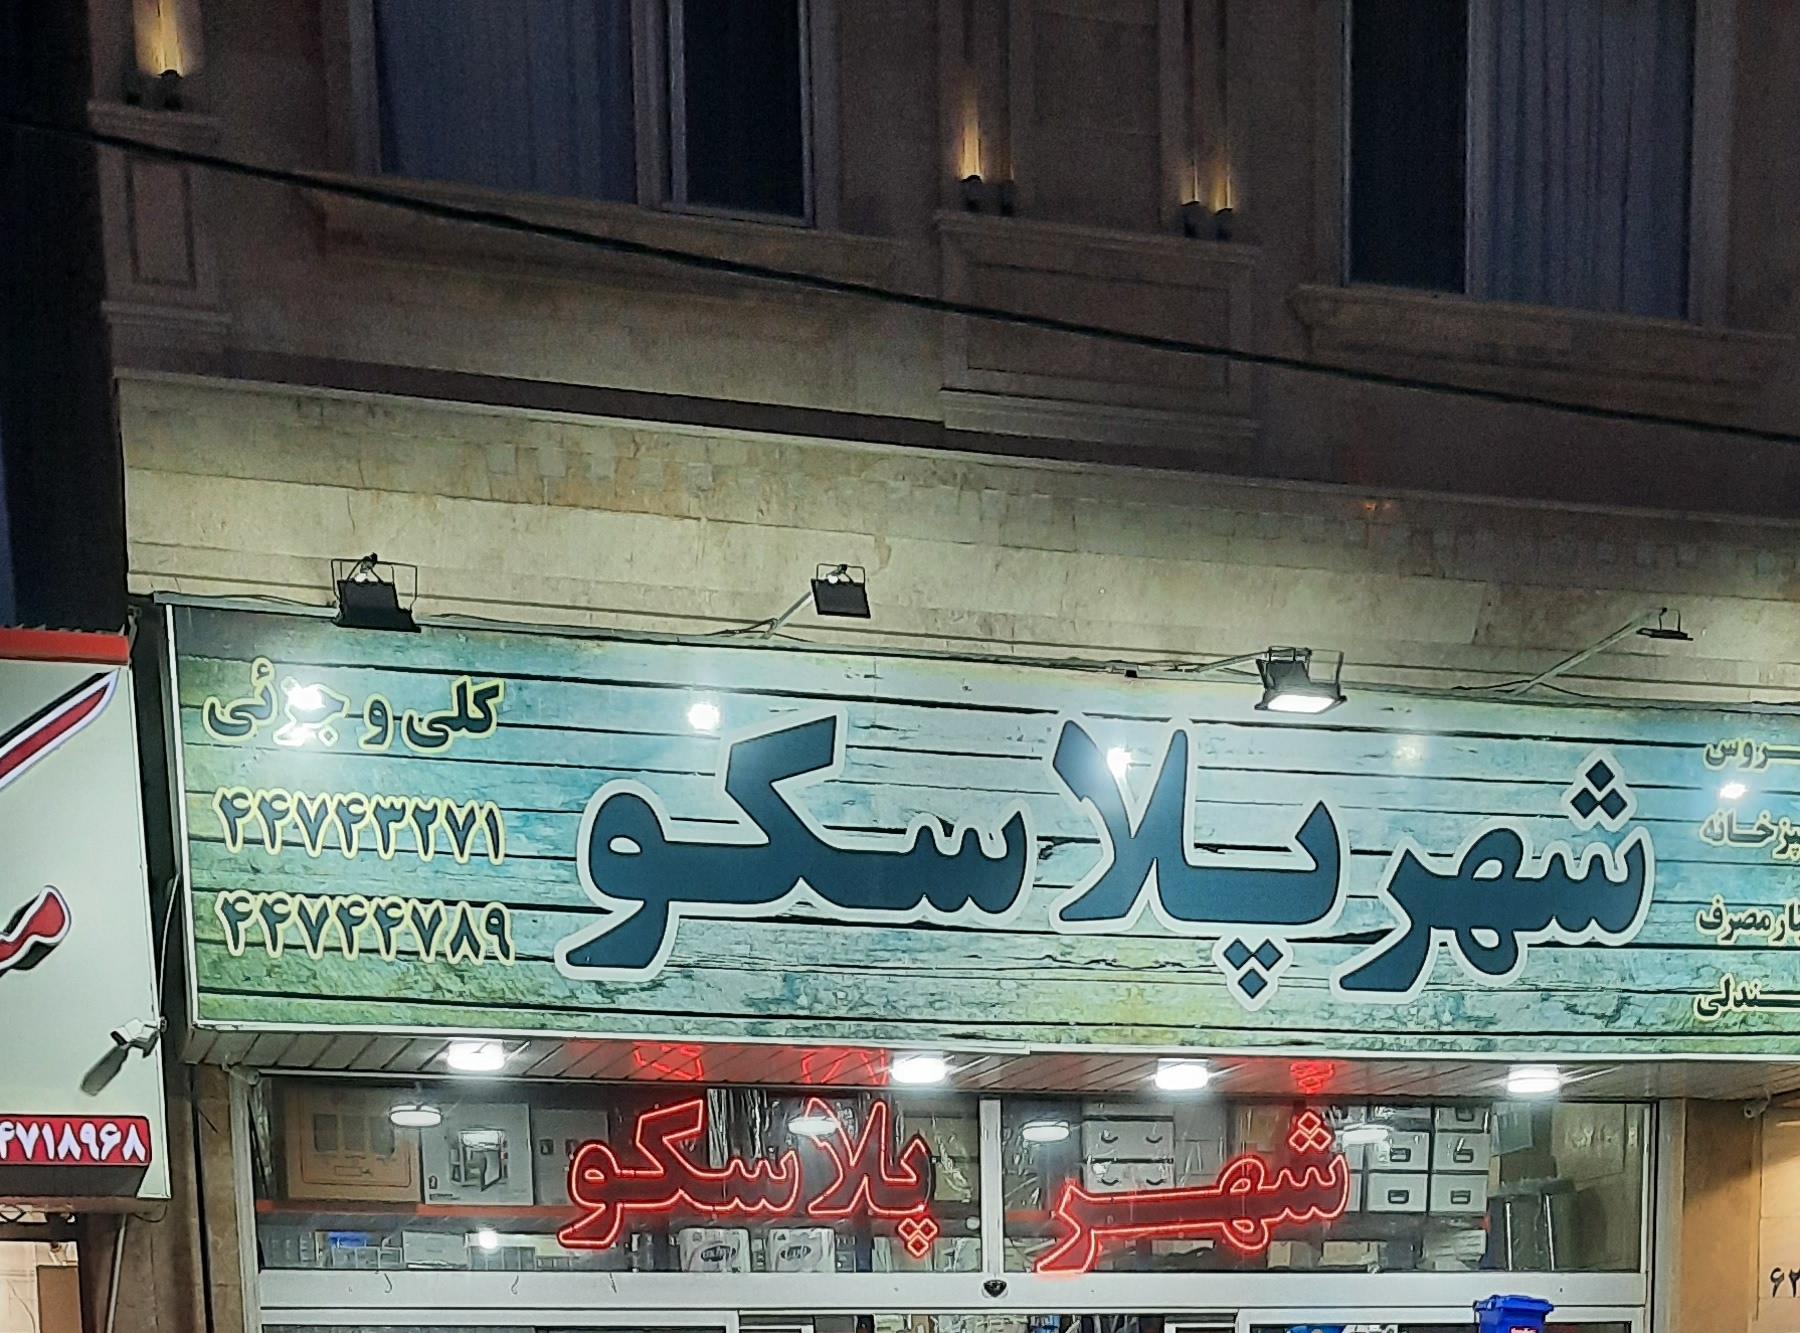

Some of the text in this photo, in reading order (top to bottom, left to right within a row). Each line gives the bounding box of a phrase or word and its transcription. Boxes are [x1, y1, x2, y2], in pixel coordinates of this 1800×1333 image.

[357, 693, 396, 750] و
[403, 676, 504, 752] کلی
[213, 788, 505, 865] ۴۴۷۴۳۲۷۱
[557, 708, 1656, 1006] شهر پلاسکو
[215, 889, 514, 965] ۴۴۷۴۴۷۸۹
[557, 1096, 1351, 1275] شهر پلاسکو
